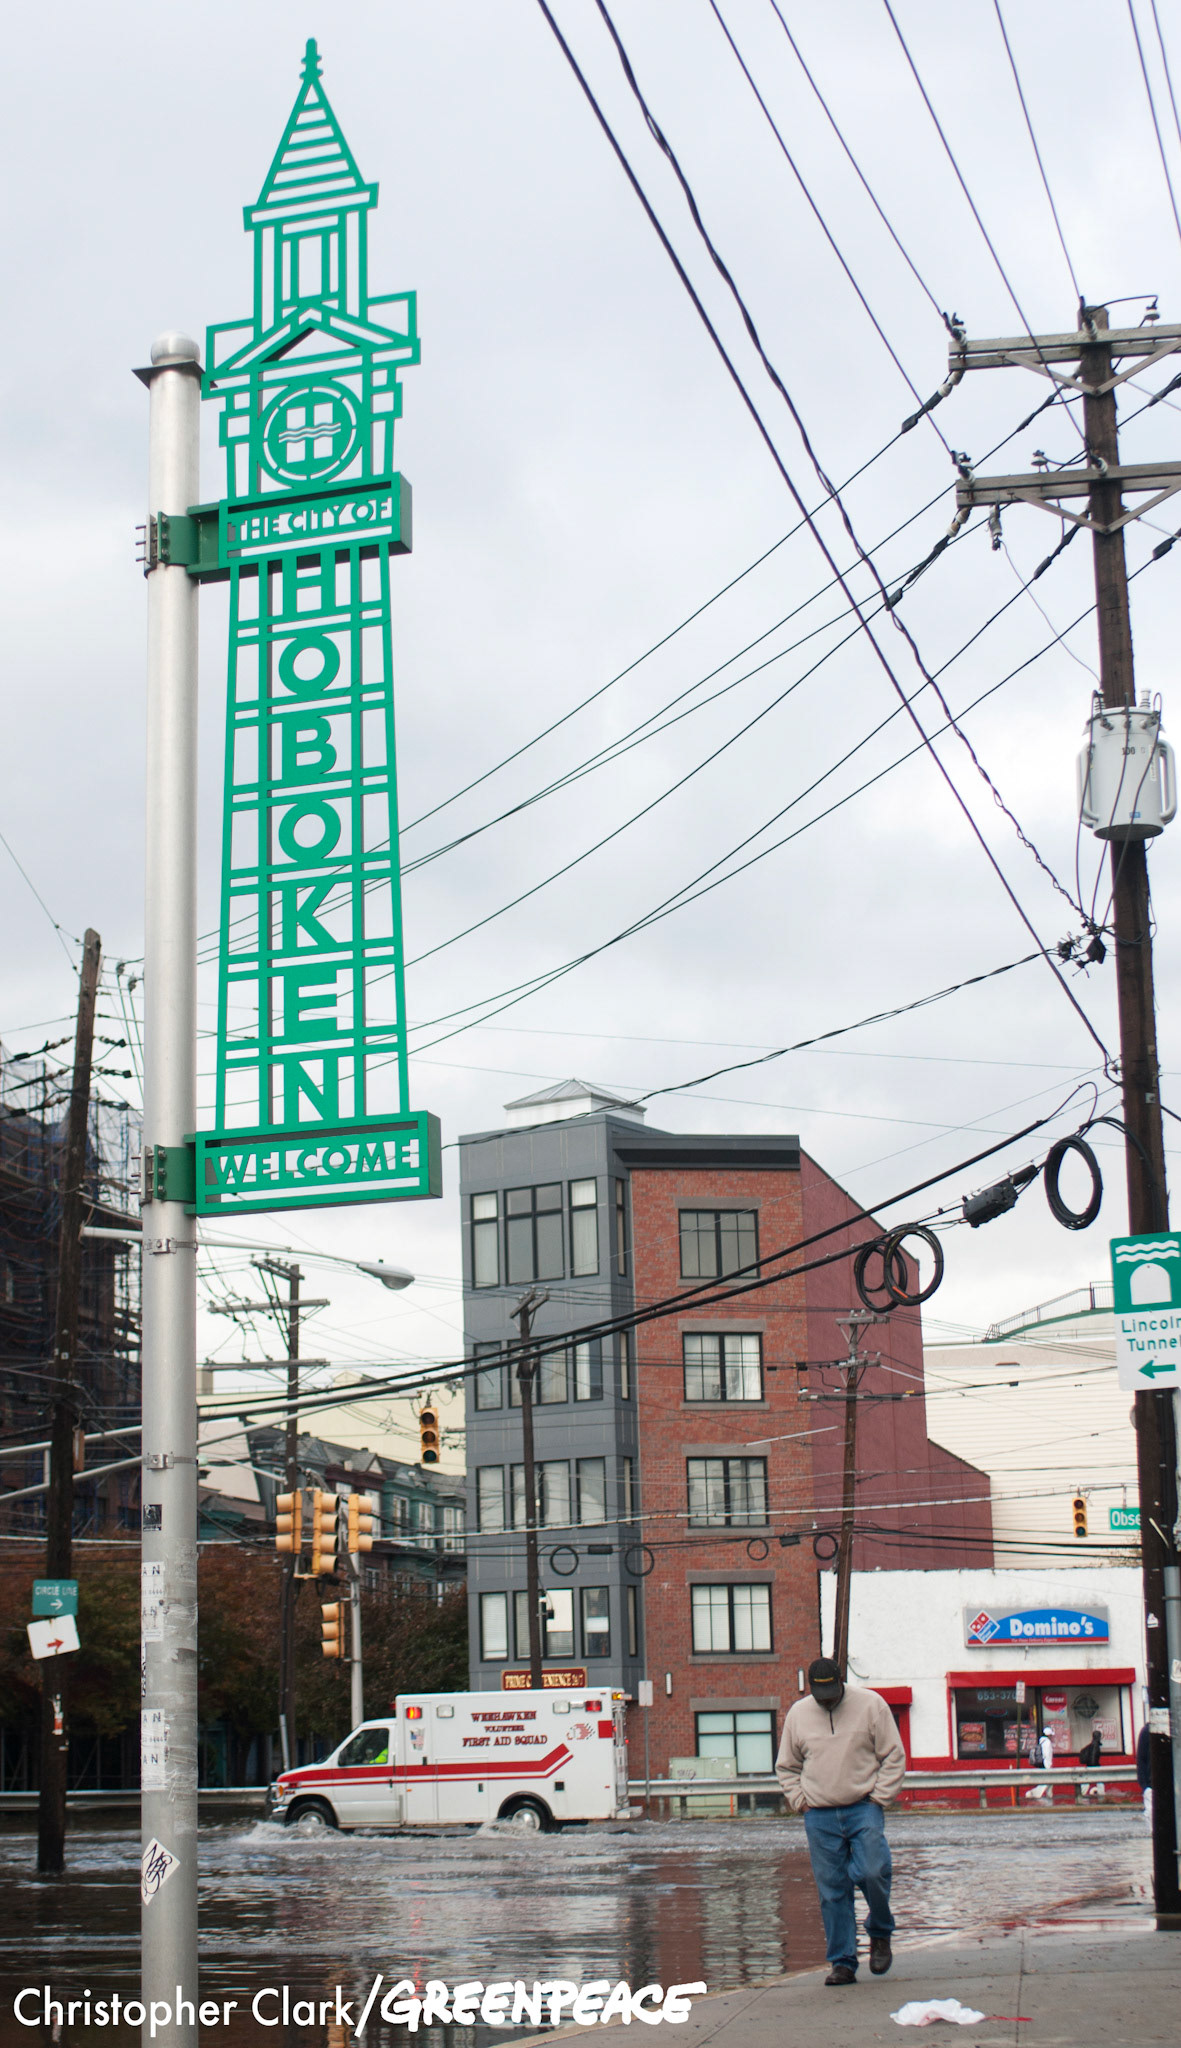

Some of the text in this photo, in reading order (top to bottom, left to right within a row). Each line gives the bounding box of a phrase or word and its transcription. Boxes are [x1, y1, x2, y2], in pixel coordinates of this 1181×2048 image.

[229, 496, 389, 542] THE CITY OF
[278, 550, 342, 1125] HOBOKEN
[211, 1138, 411, 1186] WELCOME
[35, 1586, 77, 1596] CIRCLE LINE
[1009, 1616, 1094, 1637] Domino's
[505, 1674, 526, 1688] PRIME
[471, 1710, 537, 1723] WEEHAWKEN
[484, 1724, 525, 1733] VOLUNTEER
[462, 1735, 548, 1747] FIRST AID SQUAD
